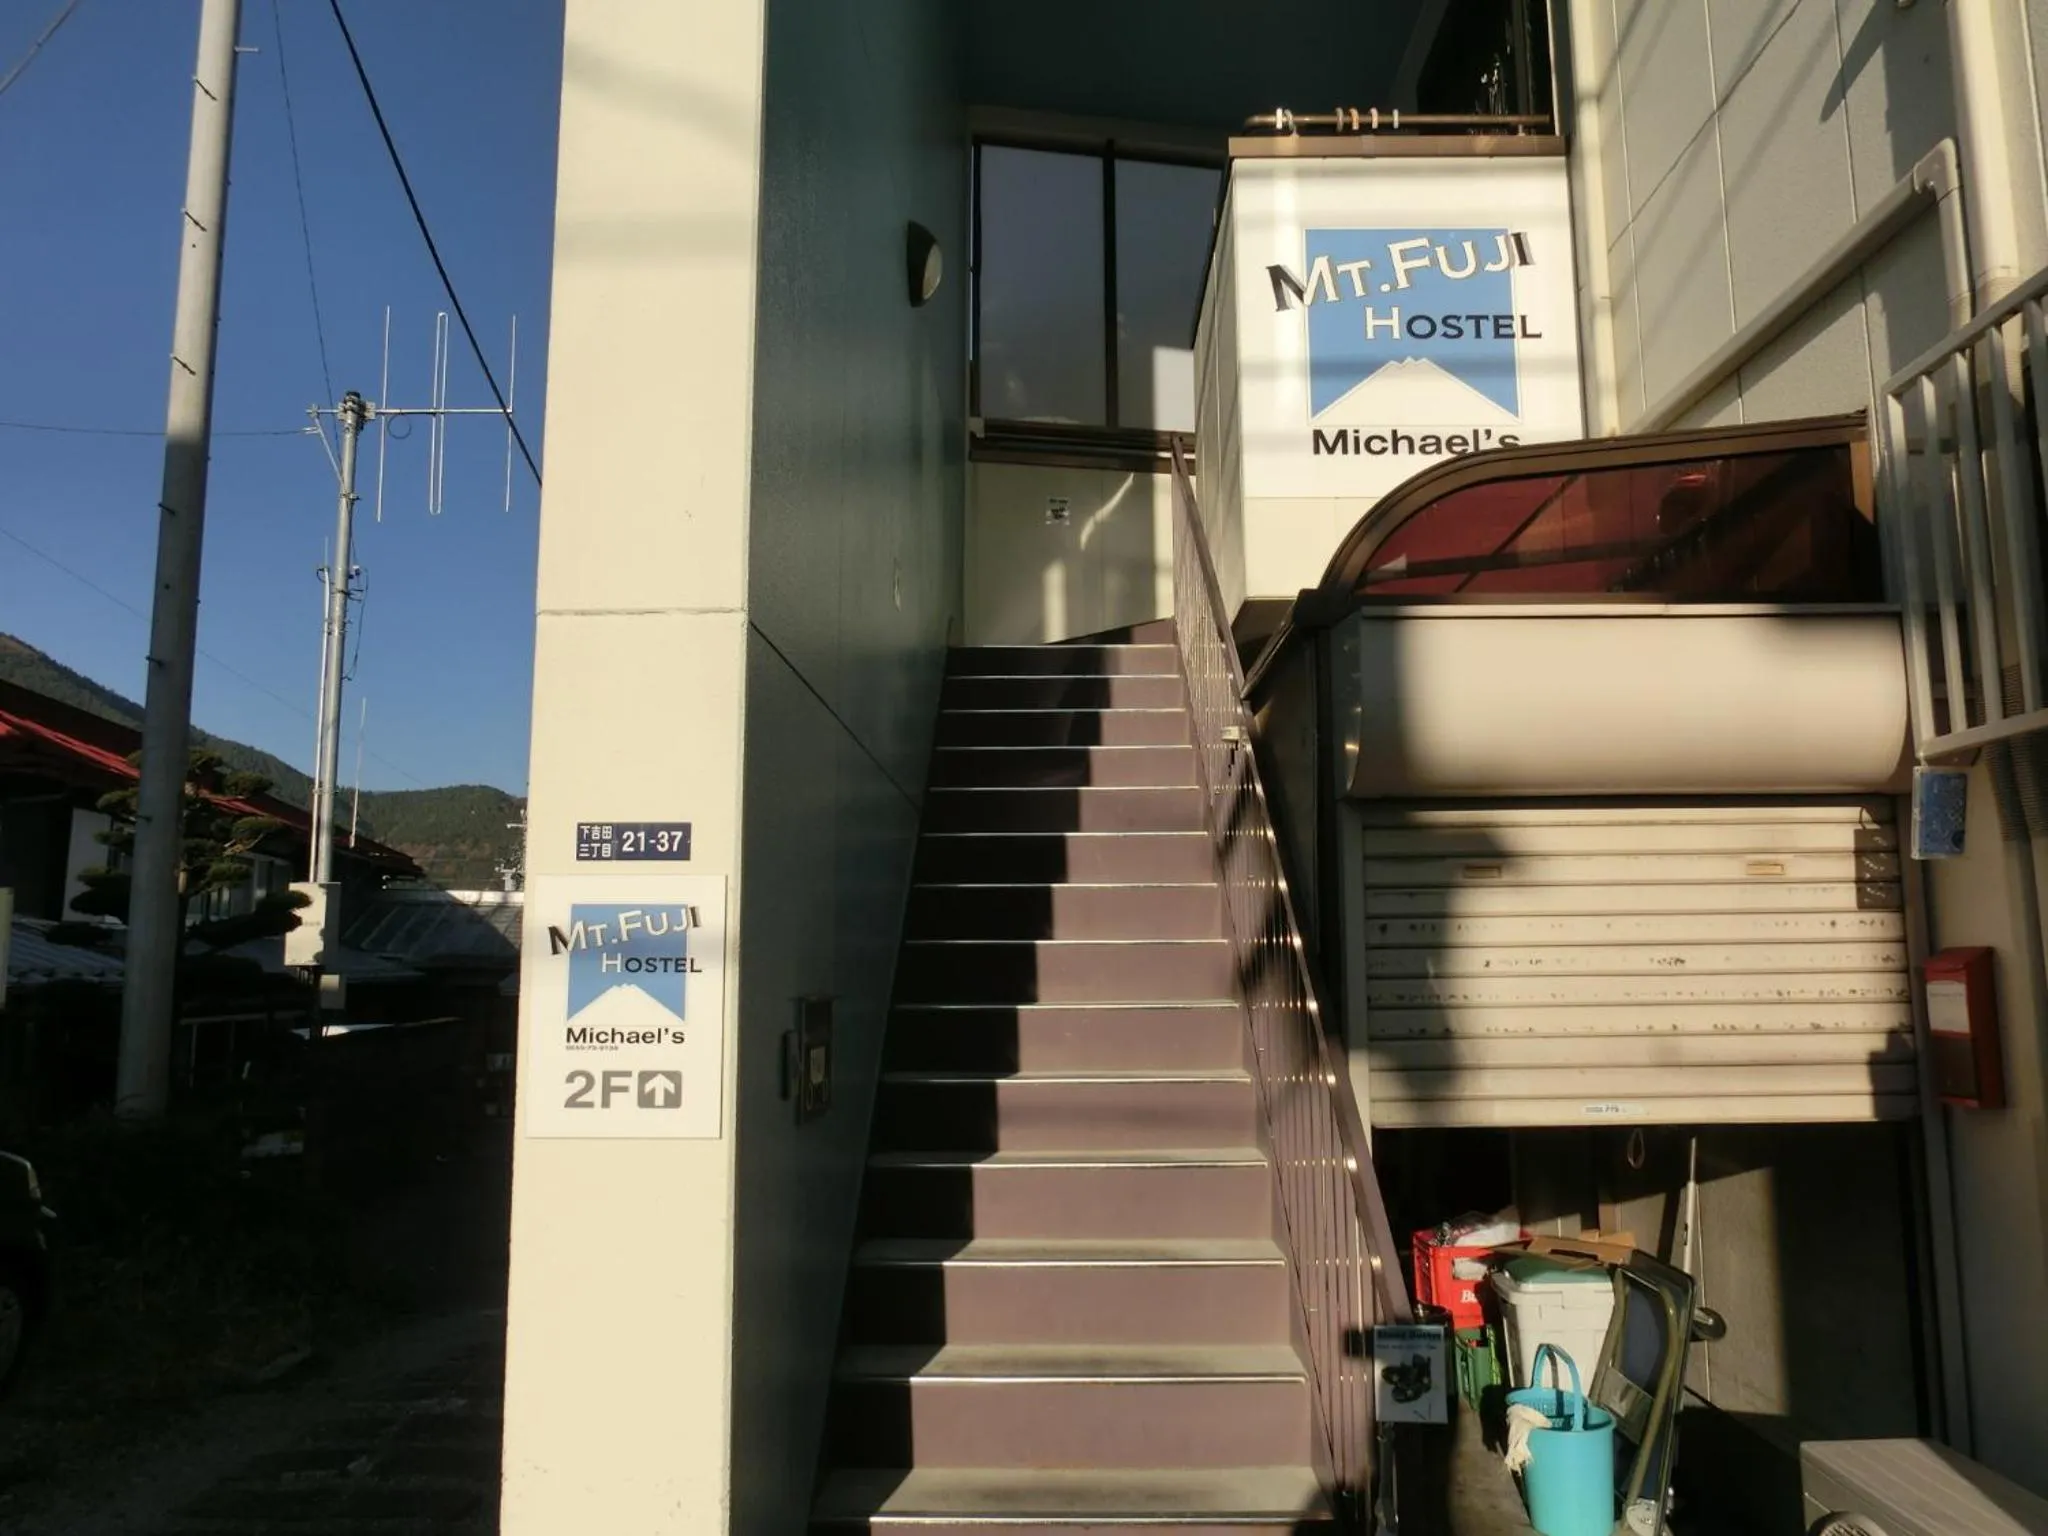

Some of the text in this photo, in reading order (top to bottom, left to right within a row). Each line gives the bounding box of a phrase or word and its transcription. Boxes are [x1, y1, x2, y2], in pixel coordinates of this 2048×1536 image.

[1365, 306, 1543, 340] HOSTEL
[580, 825, 613, 840] 下吉田
[622, 830, 683, 852] 21-37
[579, 843, 611, 858] 三丁目
[601, 953, 702, 973] HOSTEL
[565, 1027, 685, 1044] Michael's
[564, 1070, 632, 1108] 2F
